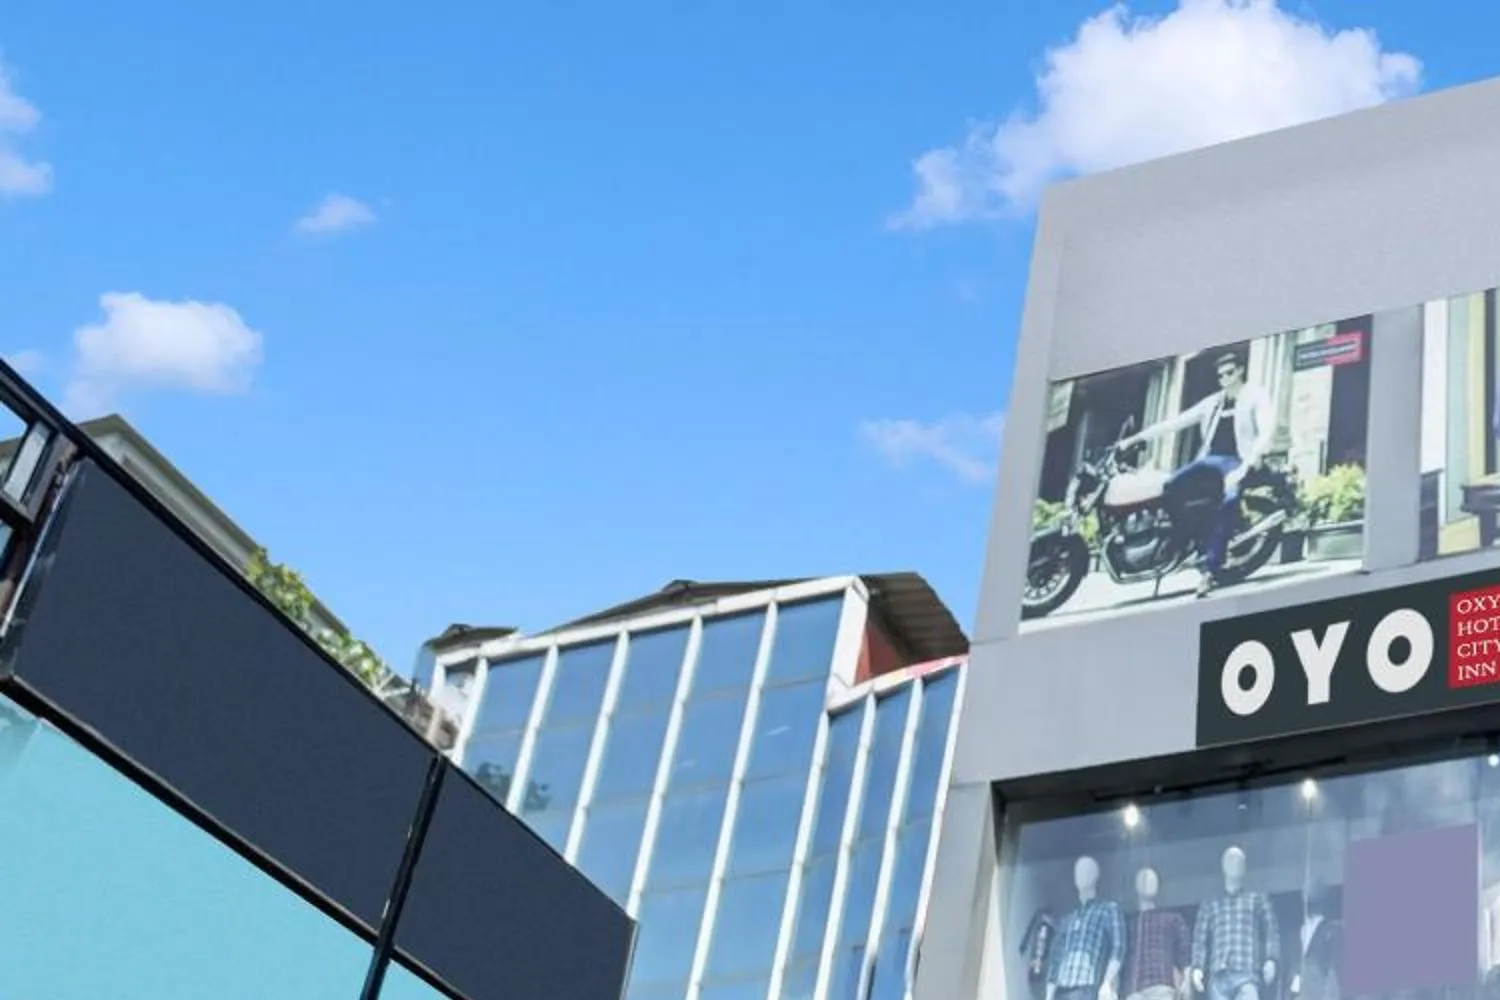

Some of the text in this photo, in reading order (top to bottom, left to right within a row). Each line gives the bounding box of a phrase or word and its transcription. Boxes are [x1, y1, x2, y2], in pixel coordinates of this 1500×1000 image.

[1457, 594, 1500, 614] OXY
[1221, 608, 1434, 716] OYO
[1457, 661, 1497, 680] INN
